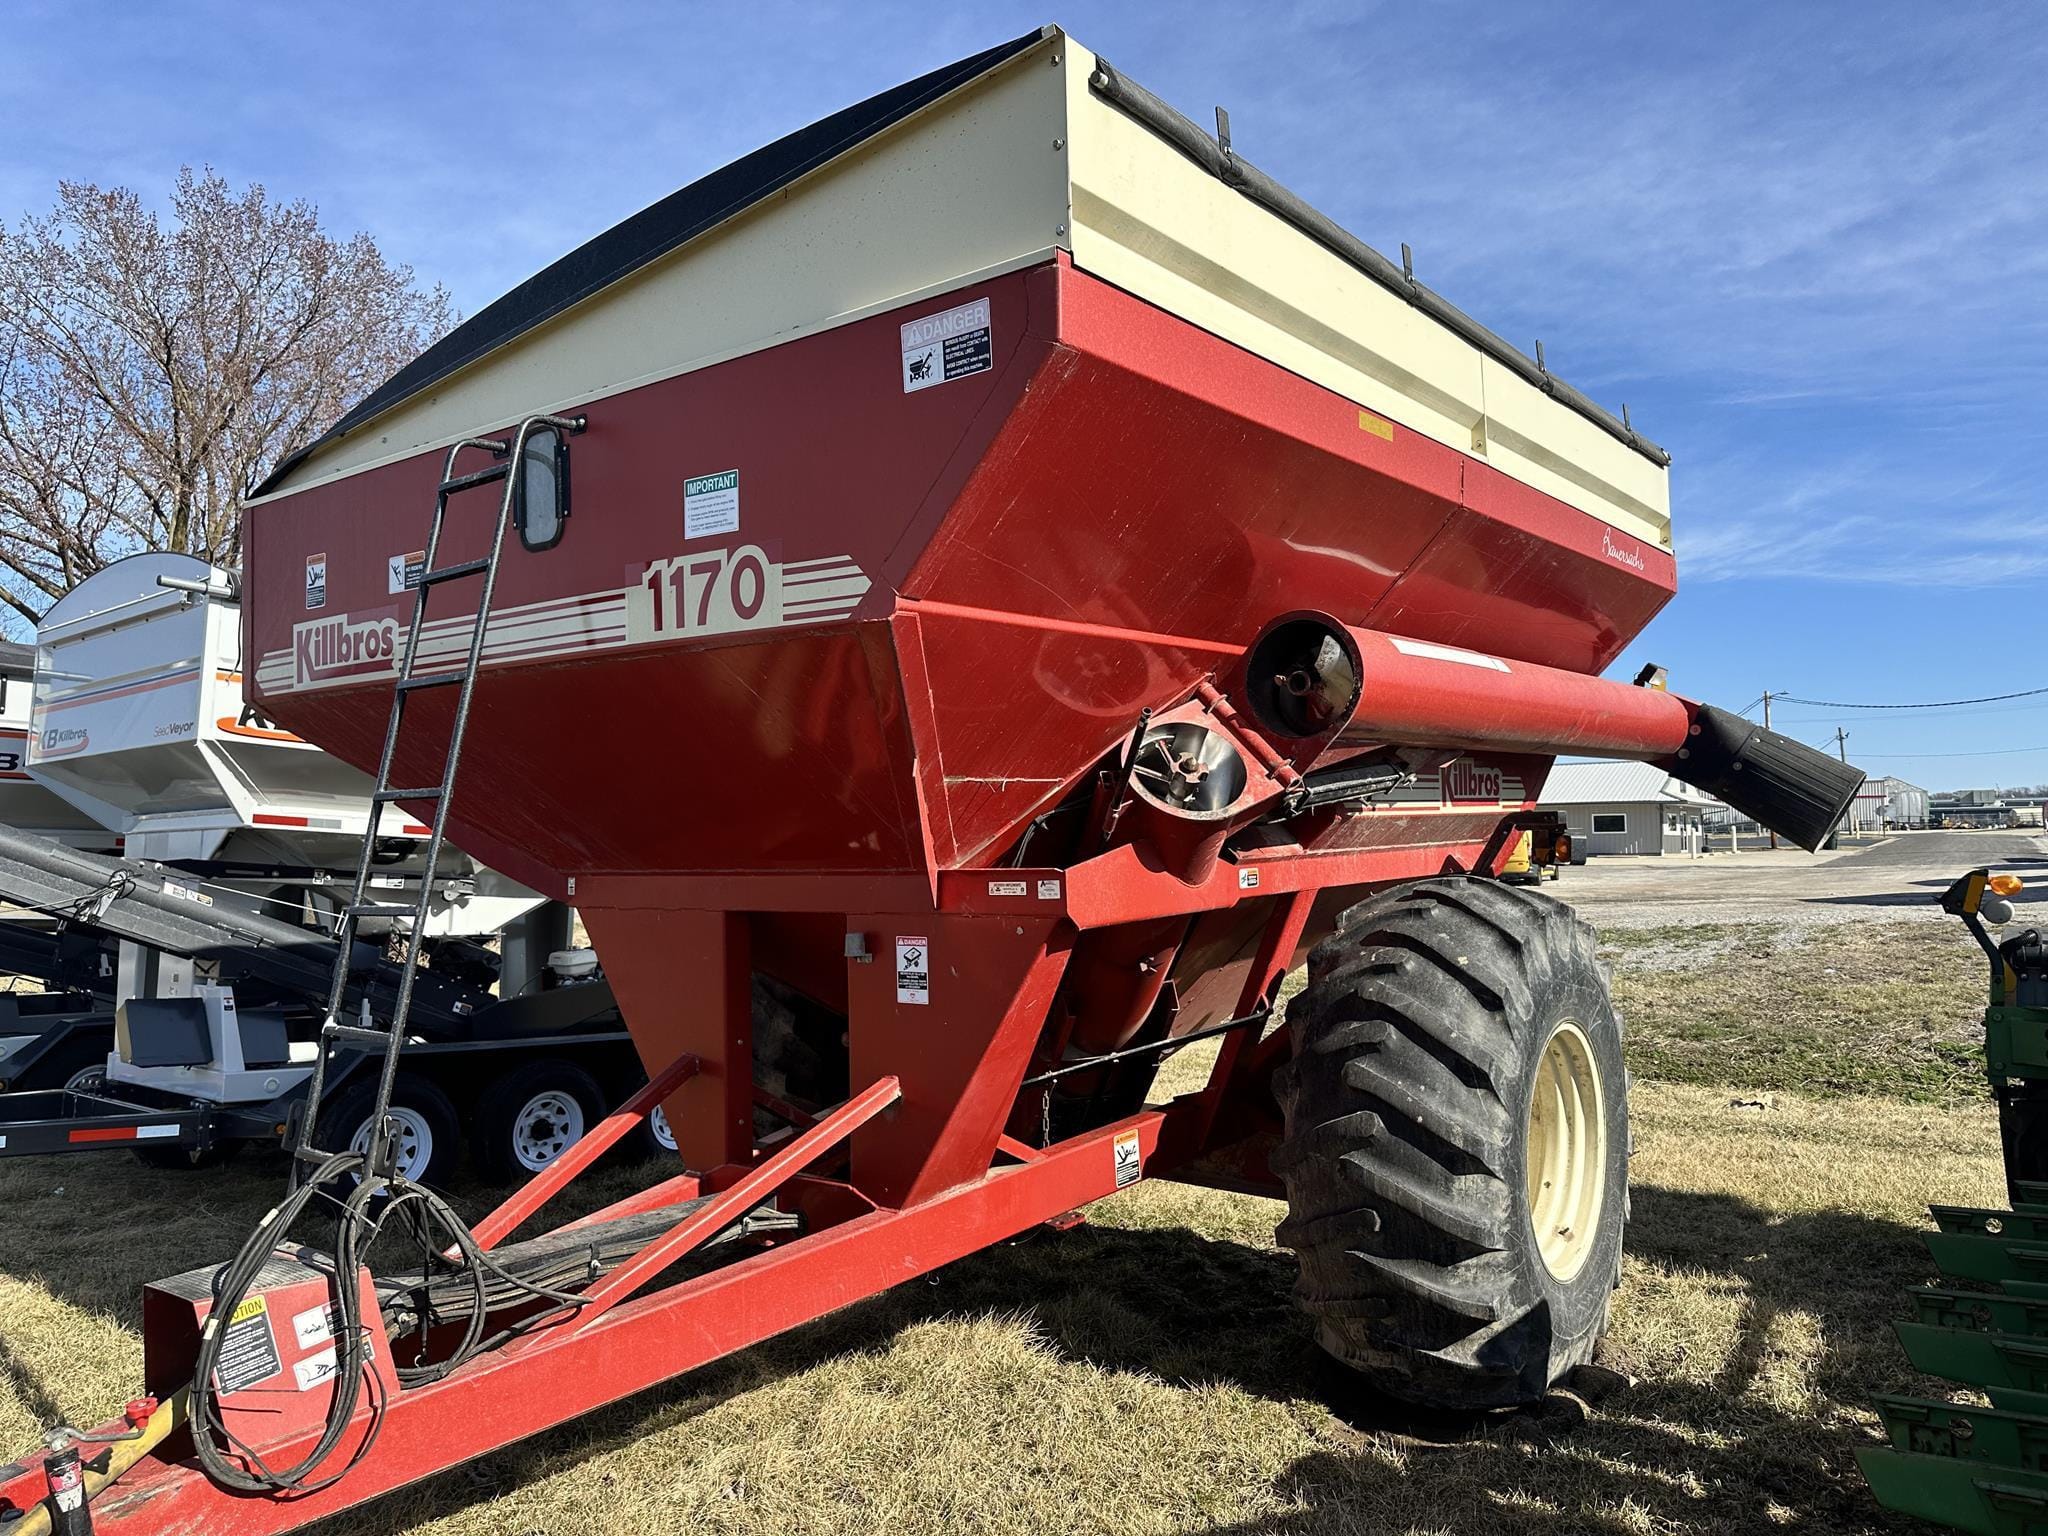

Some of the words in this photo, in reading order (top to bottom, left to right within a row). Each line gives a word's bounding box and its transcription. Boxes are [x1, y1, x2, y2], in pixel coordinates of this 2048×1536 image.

[924, 307, 984, 340] DANGER
[687, 474, 736, 495] IMPORTANT
[647, 554, 765, 632] 1170
[296, 622, 394, 684] Killbros
[58, 728, 88, 743] Killbros
[1441, 762, 1500, 807] Killbros
